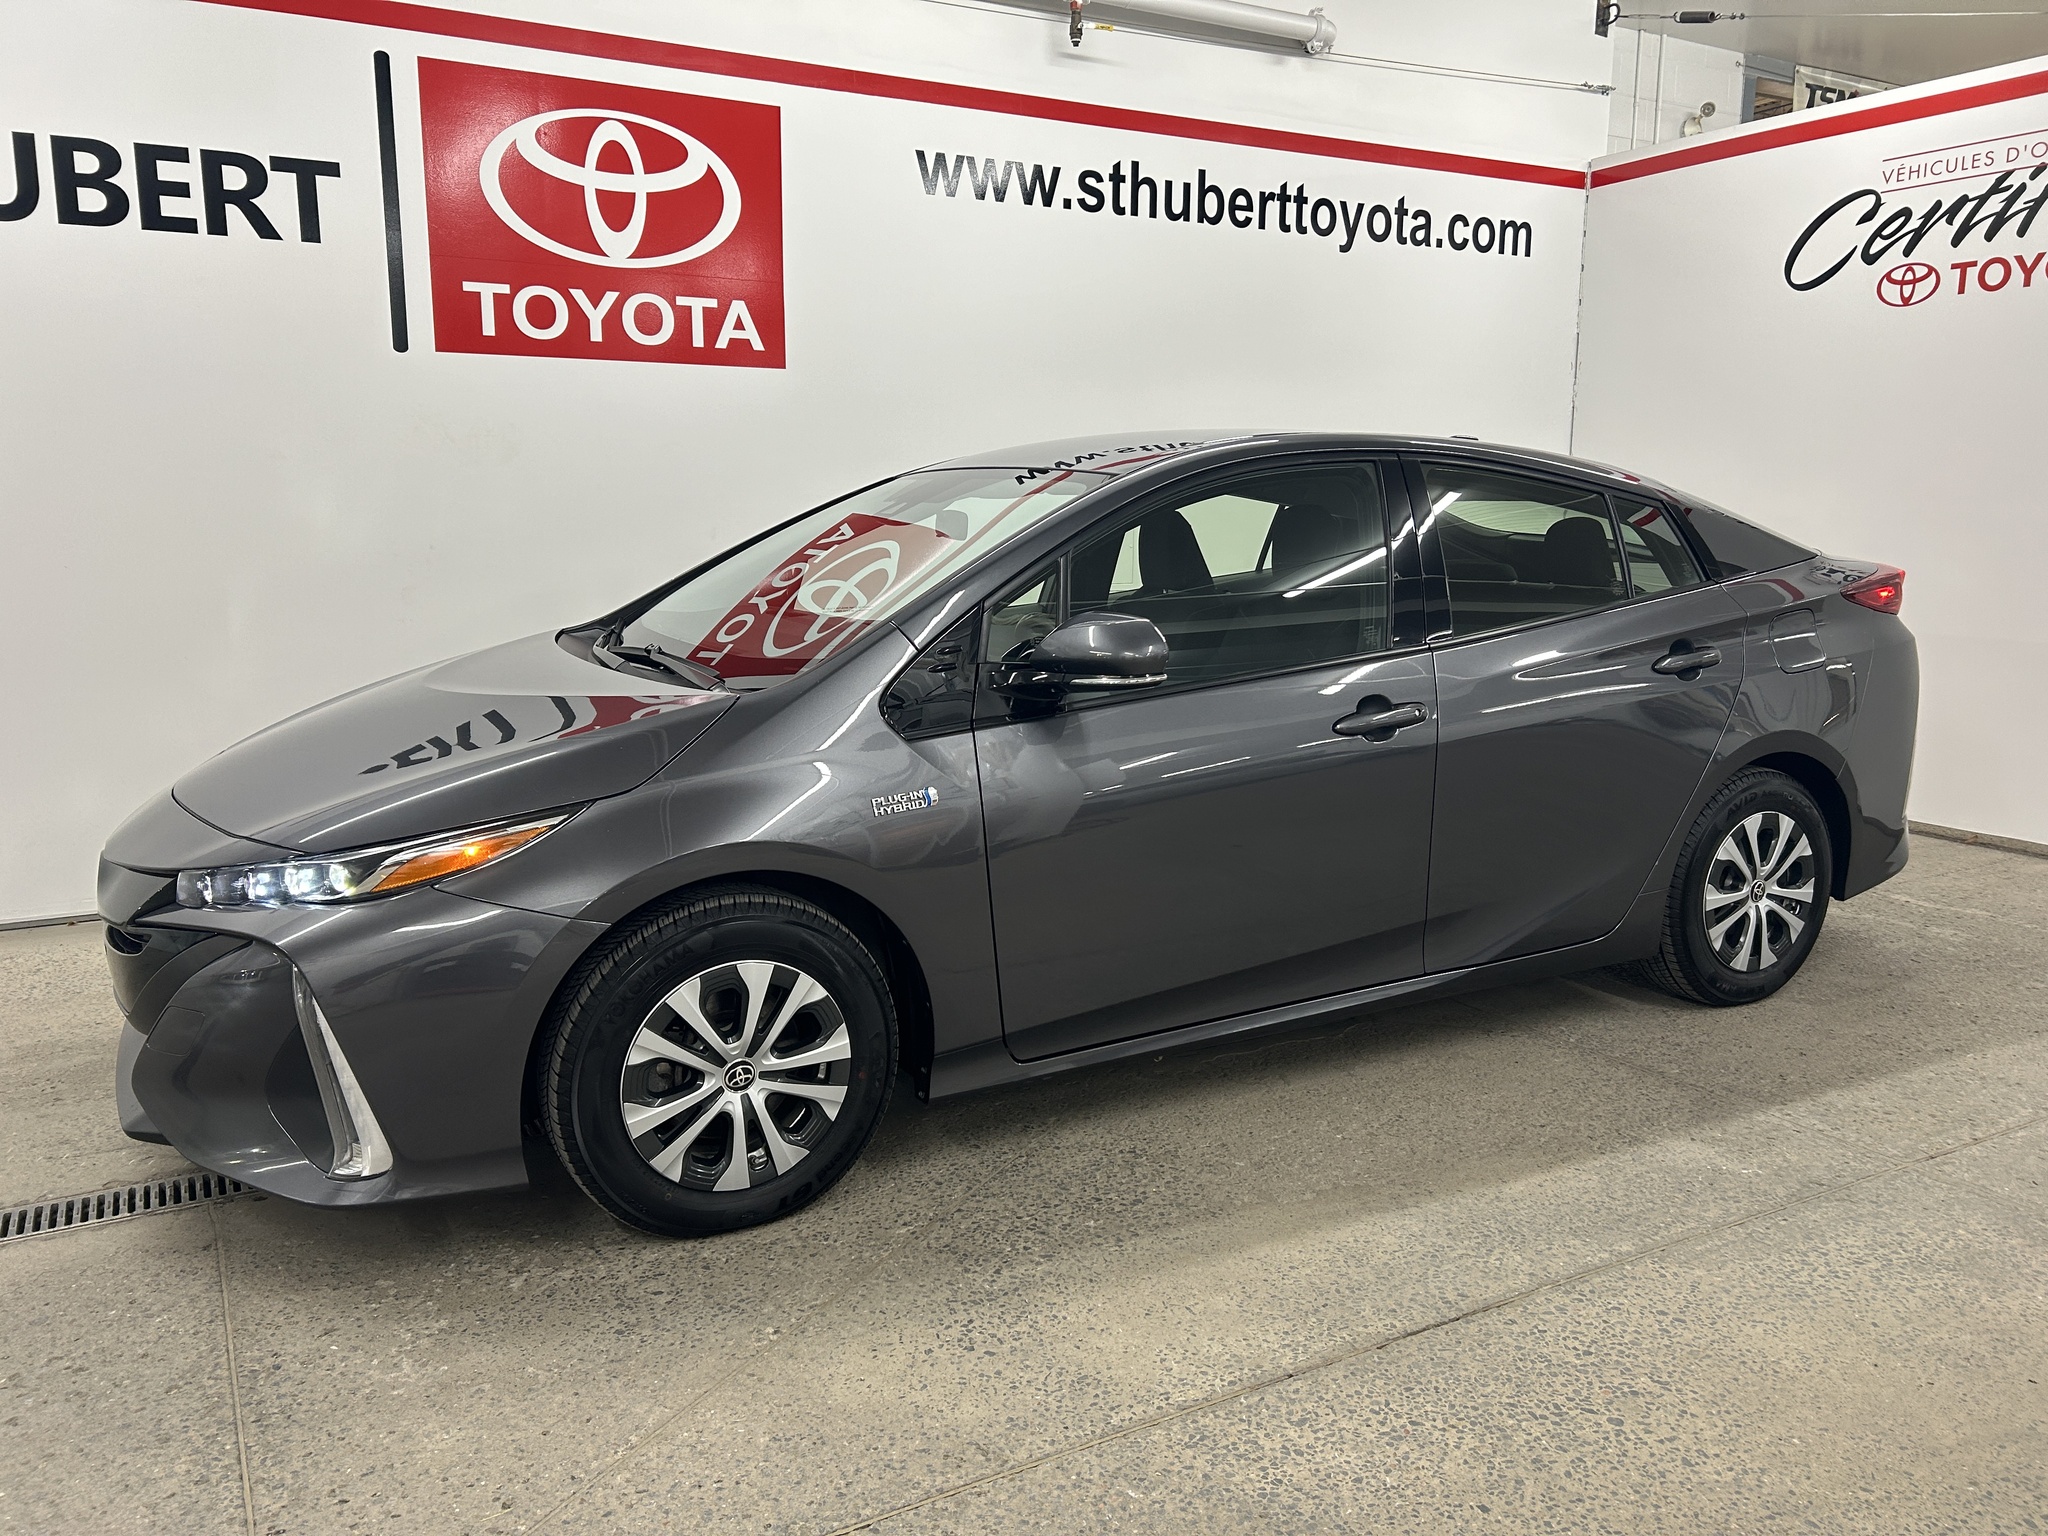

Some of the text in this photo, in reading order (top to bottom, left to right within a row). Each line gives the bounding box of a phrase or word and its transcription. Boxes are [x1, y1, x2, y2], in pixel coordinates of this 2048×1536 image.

[1882, 150, 1994, 184] VÉHICULES
[915, 149, 1533, 258] www.sthuberttoyota.com
[462, 280, 766, 351] TOYOTA
[871, 788, 924, 807] PLUG-IN
[873, 799, 926, 817] HYBRID
[604, 943, 694, 1025] YOKOHAMA
